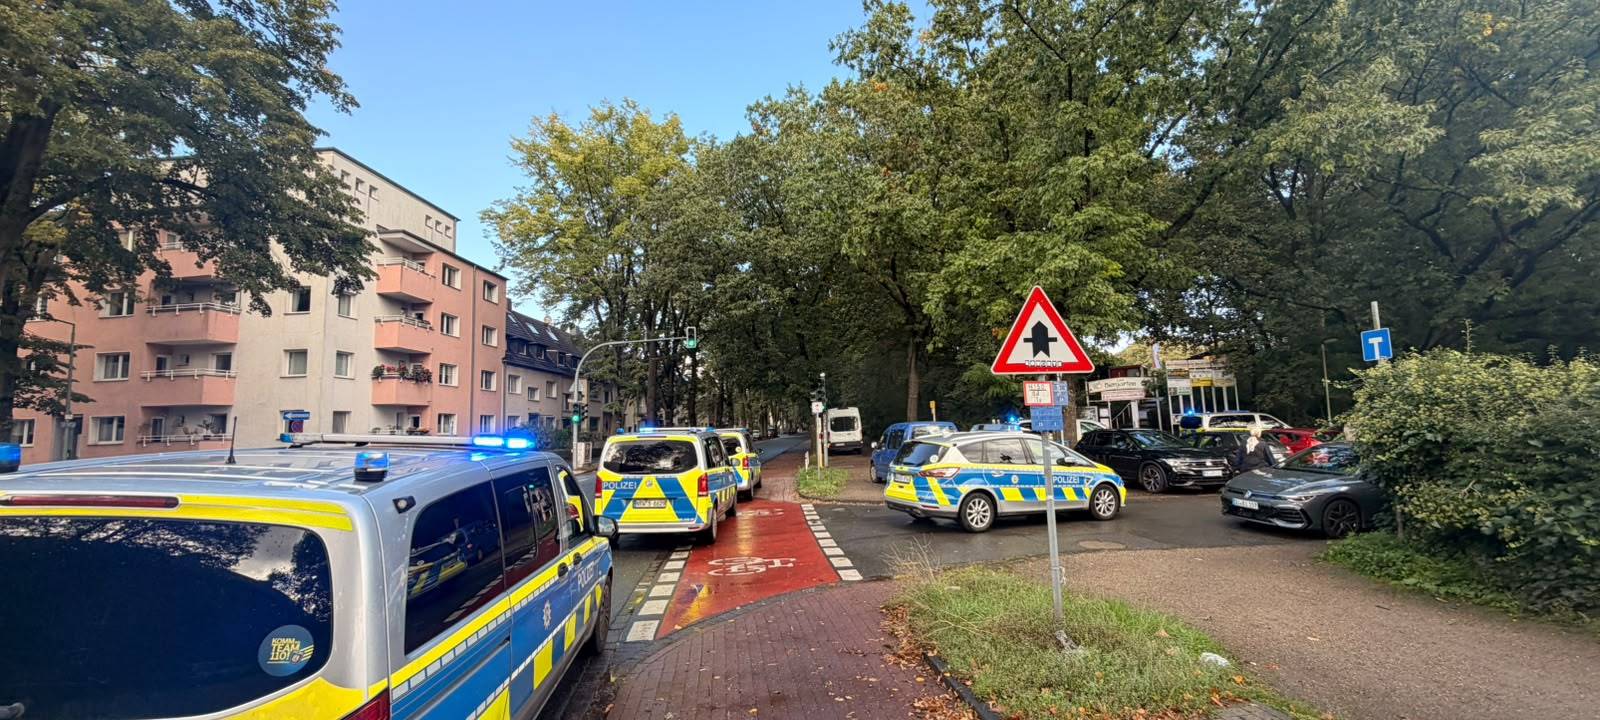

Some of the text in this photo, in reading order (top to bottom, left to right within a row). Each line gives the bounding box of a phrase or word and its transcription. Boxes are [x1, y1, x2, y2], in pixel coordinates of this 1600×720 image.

[603, 481, 637, 489] POLIZEI
[1052, 476, 1080, 484] POLIZEI
[577, 563, 596, 590] POLIZEI
[272, 642, 300, 652] TEAM
[270, 650, 291, 660] 110!
